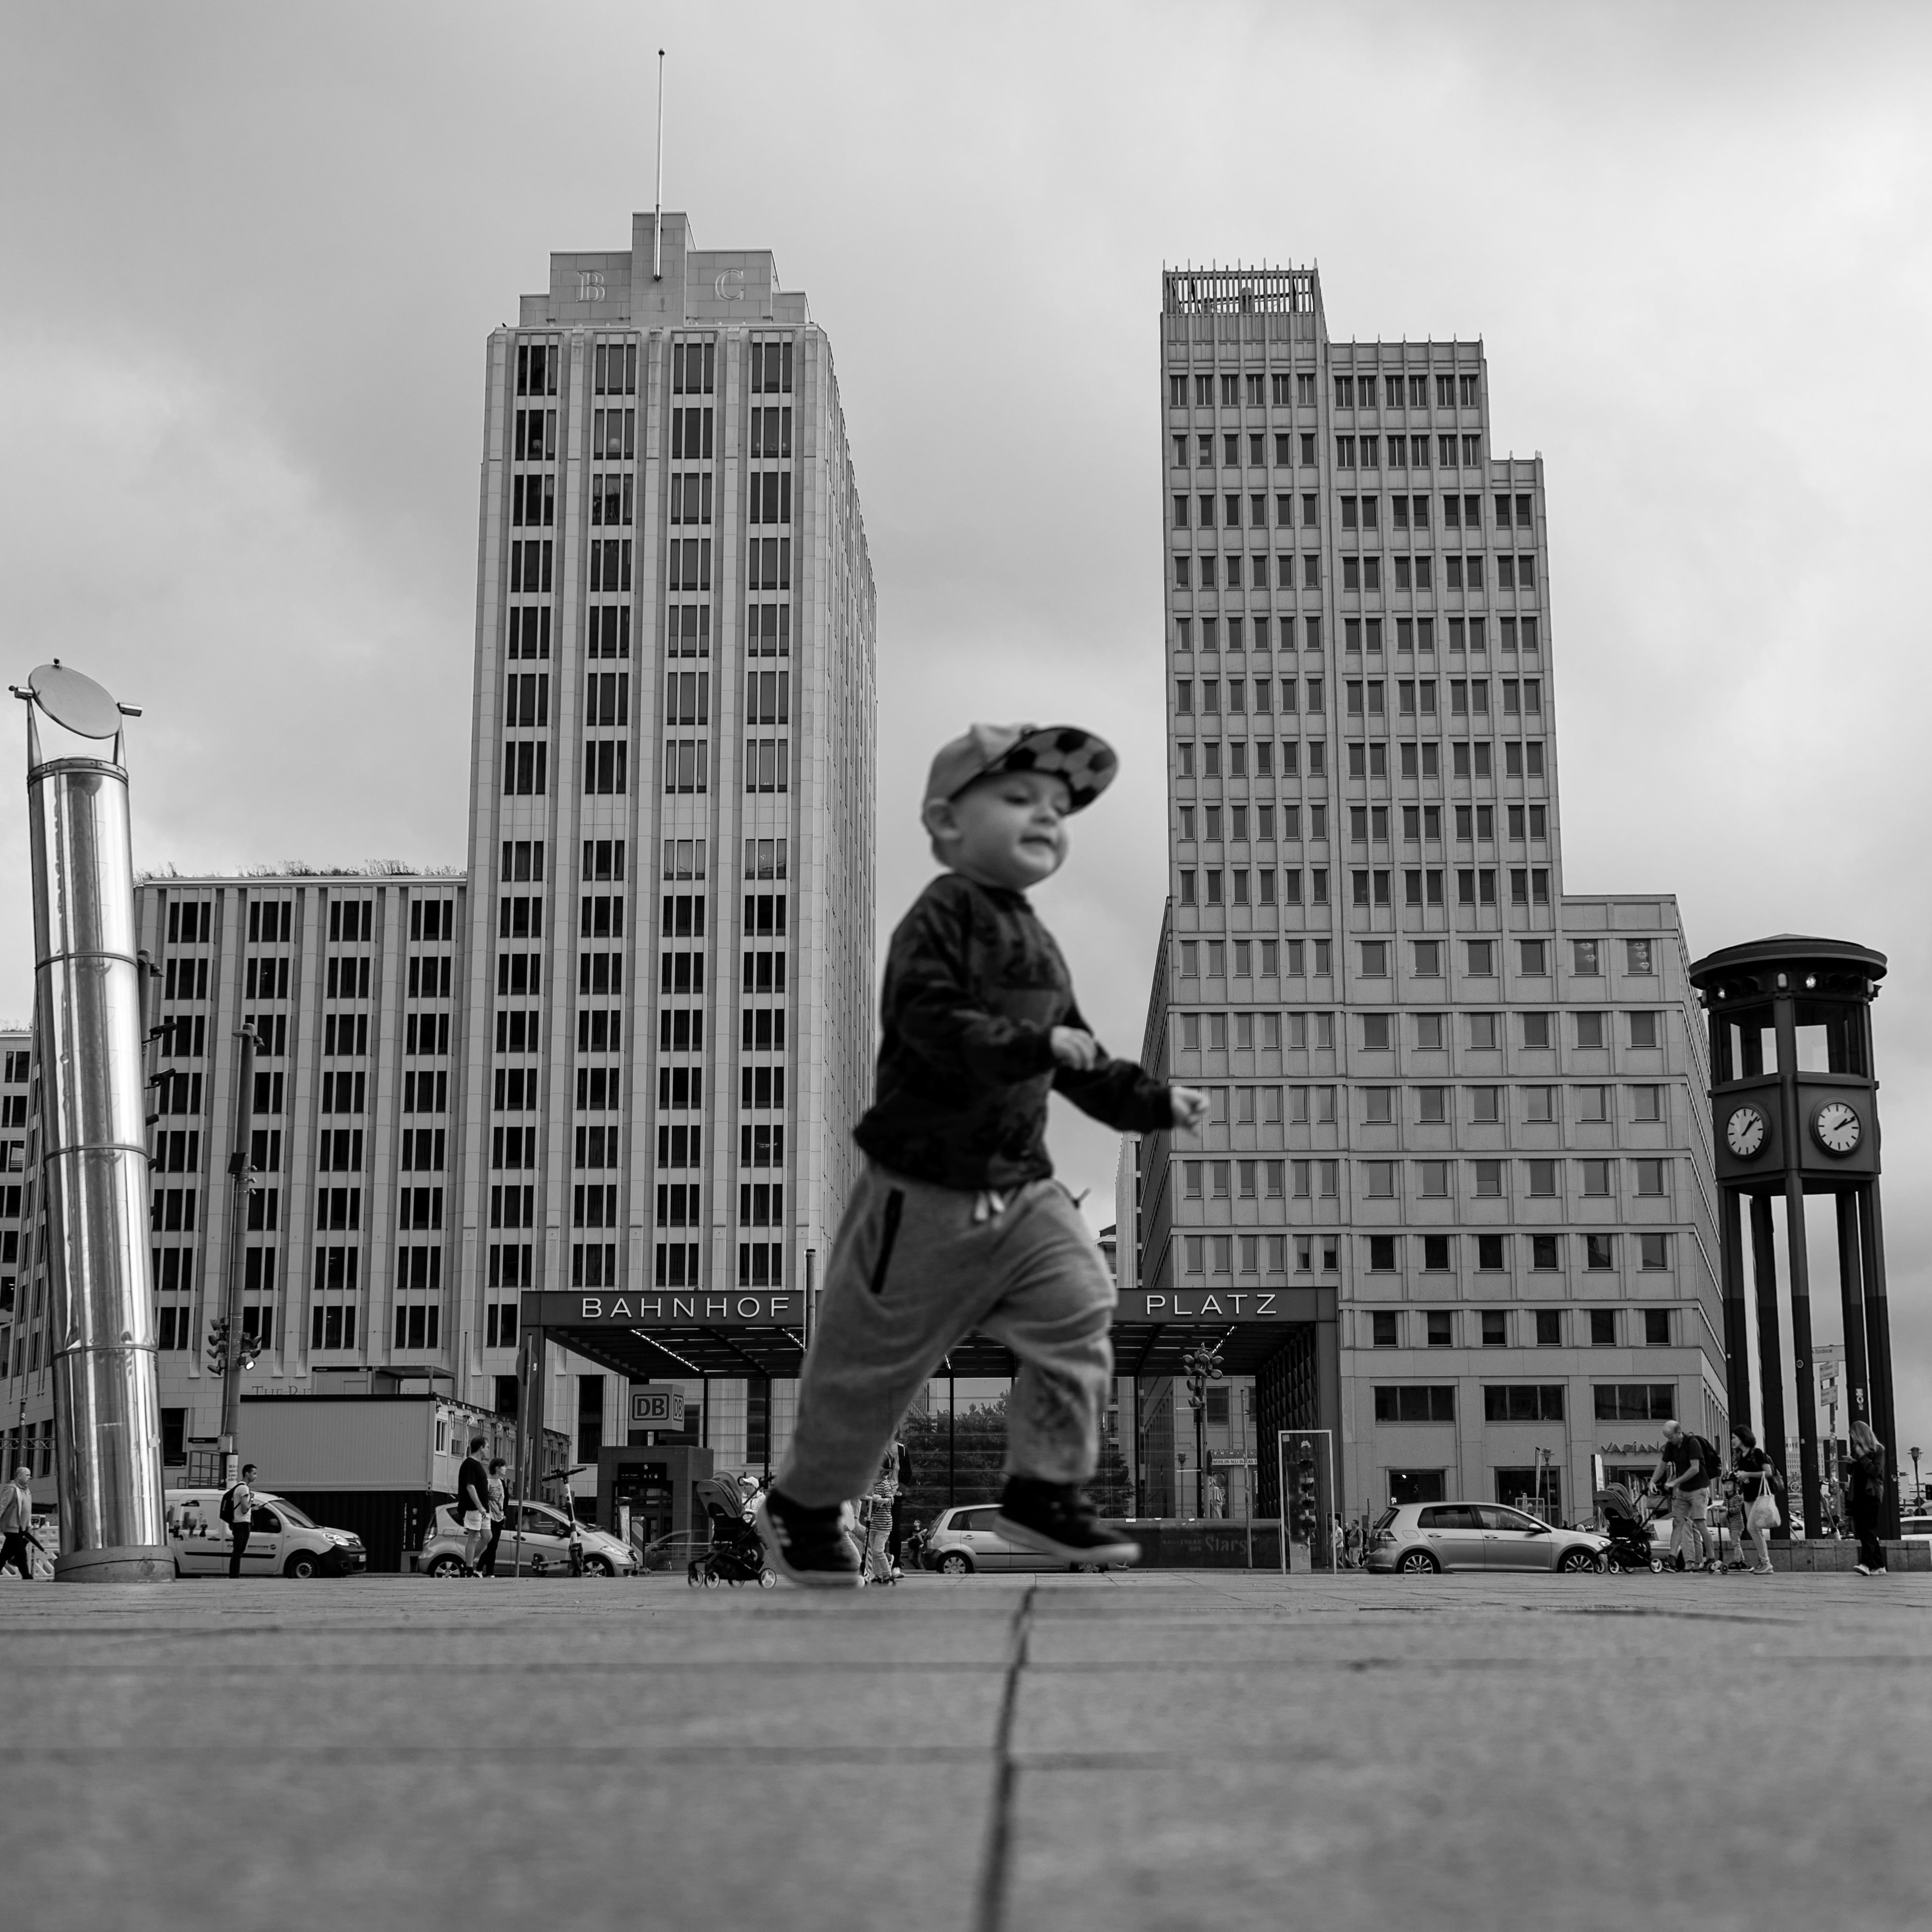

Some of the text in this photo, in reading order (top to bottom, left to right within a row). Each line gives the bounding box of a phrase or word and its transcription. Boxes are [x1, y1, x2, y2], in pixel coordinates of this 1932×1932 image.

[576, 268, 745, 303] B C
[582, 1294, 1277, 1318] BAHNHOF PLATZ
[637, 1398, 665, 1416] DB
[674, 1398, 682, 1417] DB
[1413, 1484, 1419, 1493] 5
[1205, 1533, 1247, 1555] Stars
